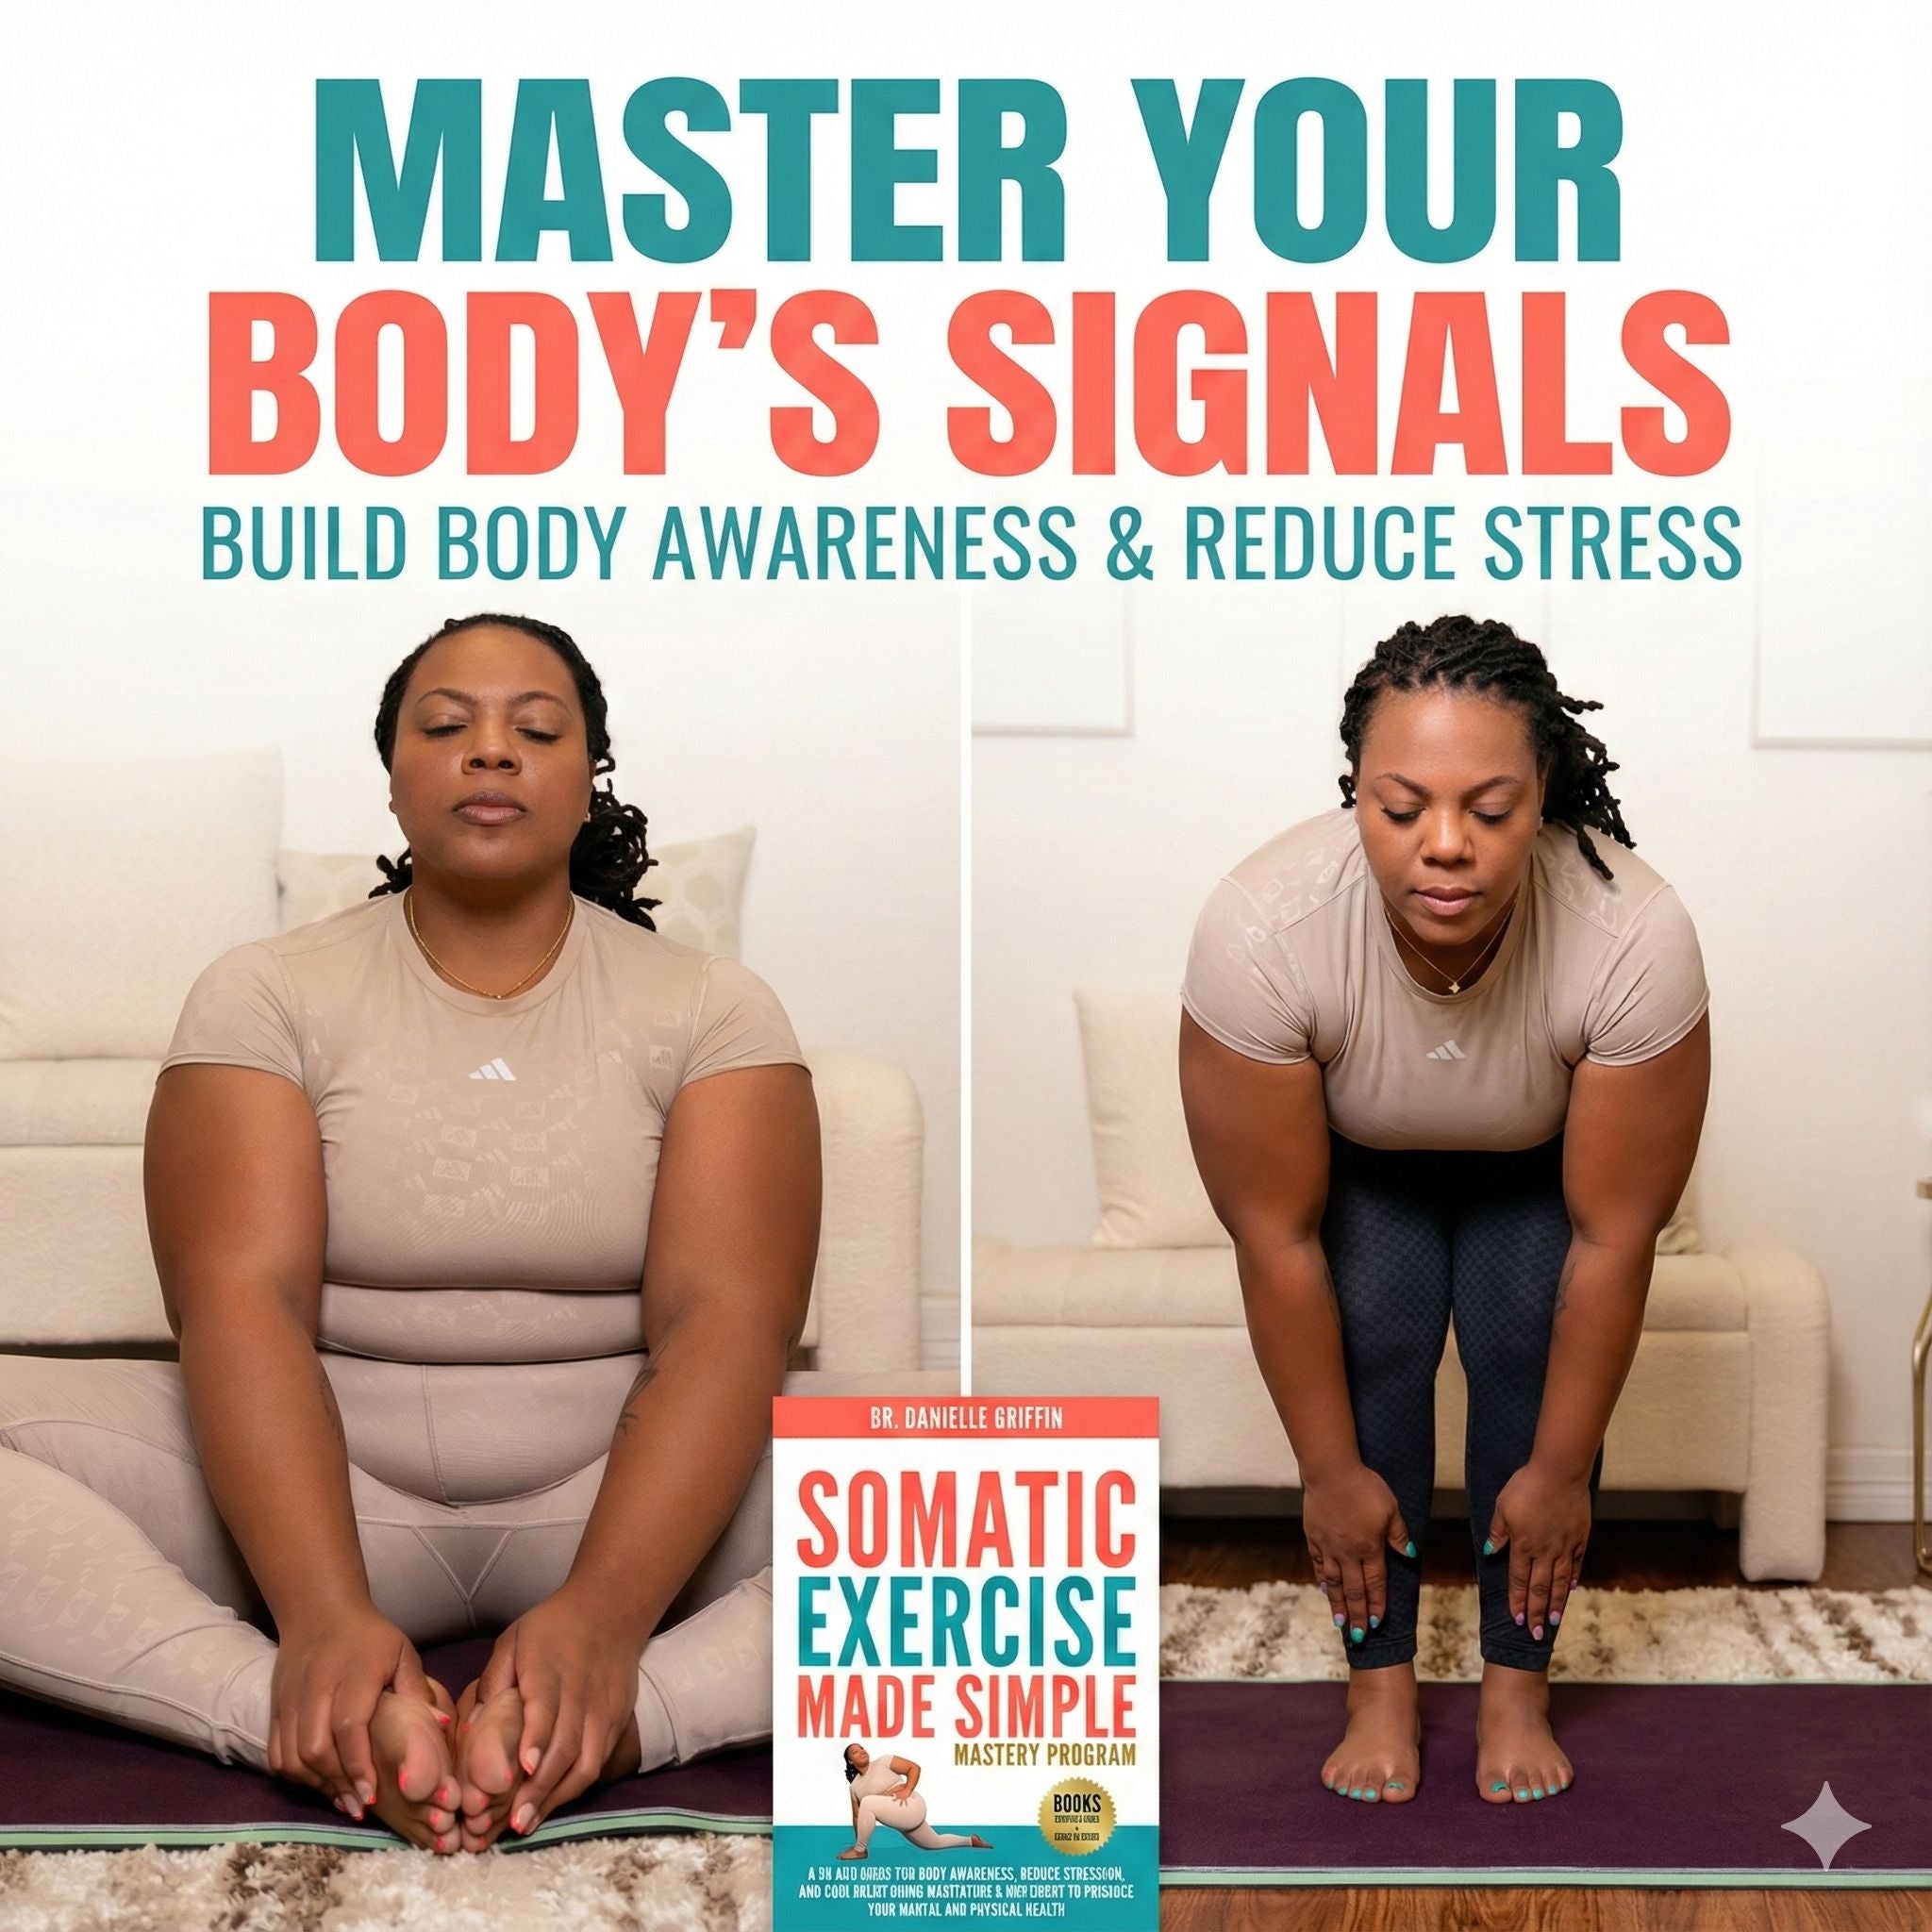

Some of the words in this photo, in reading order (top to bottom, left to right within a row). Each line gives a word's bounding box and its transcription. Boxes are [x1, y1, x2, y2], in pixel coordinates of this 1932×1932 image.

[870, 1406, 898, 1429] BR.
[905, 1406, 988, 1429] DANIELLE
[994, 1406, 1063, 1429] GRIFFIN
[797, 1470, 1136, 1568] SOMATIC
[798, 1575, 1136, 1667] EXERCISE
[798, 1674, 935, 1739] MADE
[955, 1674, 1136, 1739] SIMPLE
[954, 1743, 1041, 1766] MASTERY
[1047, 1743, 1137, 1766] PROGRAM
[1053, 1793, 1102, 1813] BOOKS
[919, 1866, 947, 1880] BODY
[950, 1866, 1018, 1883] AWARENESS,
[798, 1884, 822, 1898] AND
[867, 1902, 896, 1917] YOUR
[970, 1902, 1023, 1917] PHYSICAL
[1025, 1902, 1065, 1917] HEALTH
